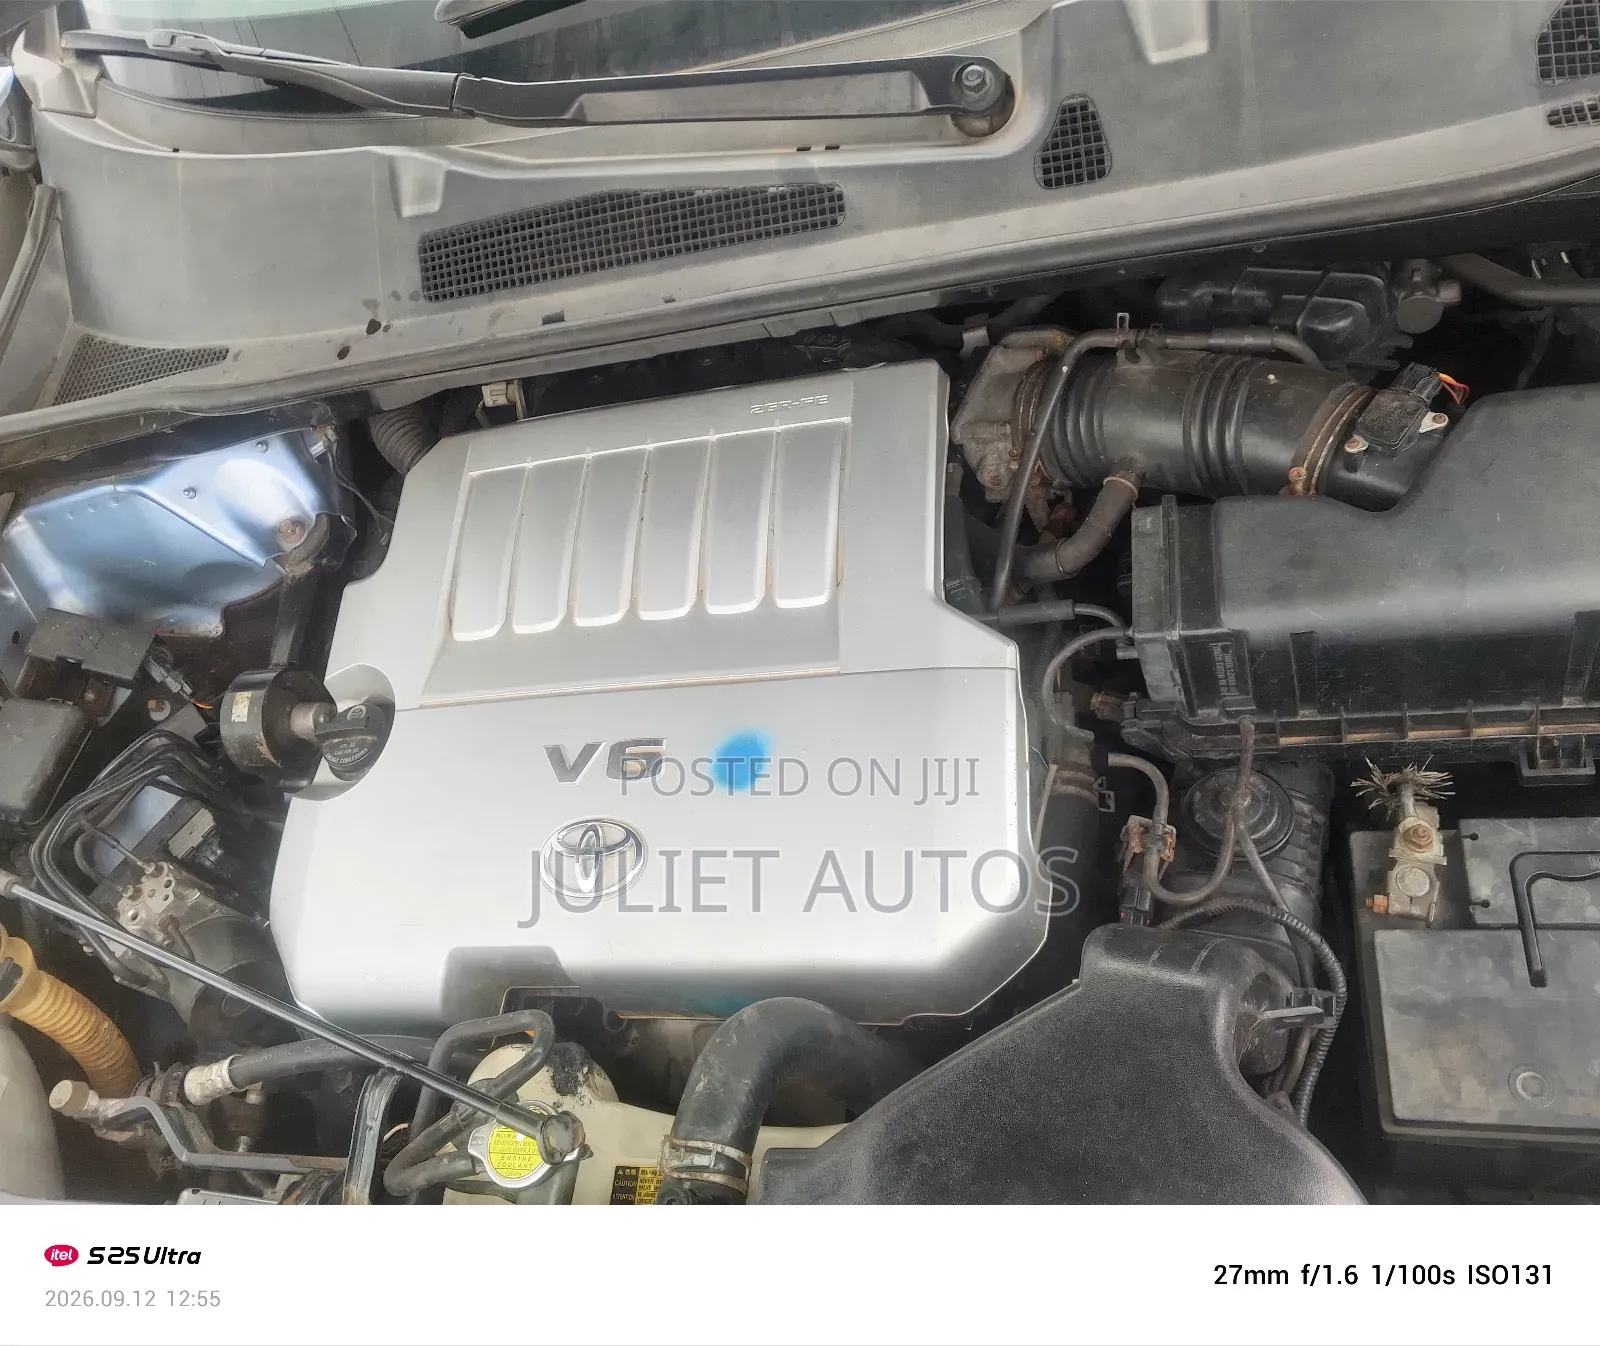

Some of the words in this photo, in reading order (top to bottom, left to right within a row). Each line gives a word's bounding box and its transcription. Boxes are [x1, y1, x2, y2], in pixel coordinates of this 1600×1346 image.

[750, 394, 829, 414] 2GR-FE
[541, 737, 668, 786] V6
[500, 1154, 533, 1162] ENGINE
[496, 1161, 534, 1169] COOLANT
[614, 1179, 637, 1187] CAUTION
[612, 1192, 635, 1201] ATTENTION
